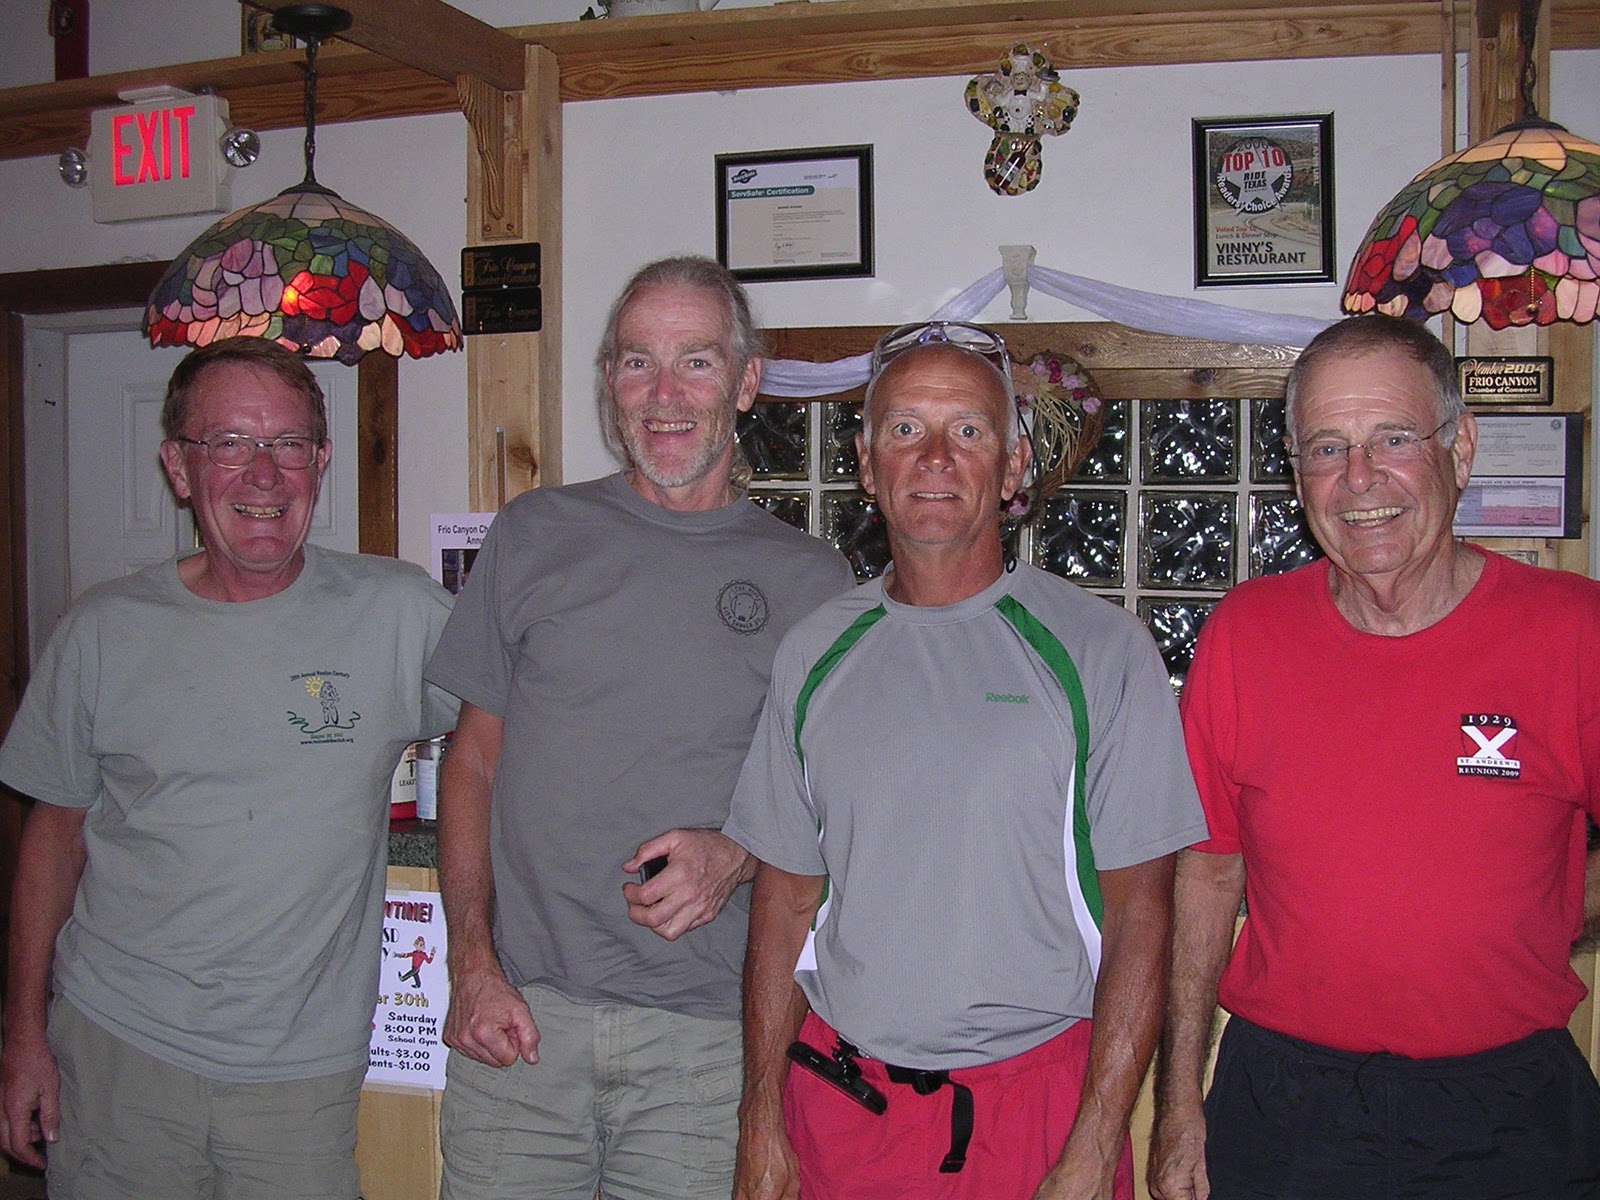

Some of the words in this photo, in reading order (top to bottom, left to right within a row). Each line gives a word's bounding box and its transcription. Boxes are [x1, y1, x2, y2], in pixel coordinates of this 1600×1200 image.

[112, 106, 195, 187] EXIT
[1224, 151, 1254, 172] TOP
[1262, 147, 1285, 168] 10
[1243, 171, 1266, 181] RIDE
[1244, 180, 1267, 190] TEXAS
[1244, 200, 1277, 212] Choice
[1275, 165, 1292, 201] Awards
[766, 187, 809, 196] Certification
[1216, 241, 1273, 254] VINNY'S
[1217, 252, 1306, 266] RESTAURANT
[1504, 363, 1545, 374] 2004
[1469, 376, 1494, 387] FRIO
[1495, 376, 1537, 387] CANYON
[438, 525, 451, 534] Frio
[453, 525, 478, 535] Canyon
[985, 692, 1030, 704] Reebok
[1468, 714, 1512, 727] 1929
[1458, 767, 1499, 776] REUNION
[1501, 769, 1519, 777] 2009
[399, 779, 416, 787] LEAKE
[394, 992, 429, 1008] 30th
[388, 1011, 437, 1026] Saturday
[384, 1024, 414, 1034] 8:00
[419, 1026, 437, 1036] PM
[388, 1035, 416, 1044] School
[419, 1037, 438, 1047] Gym
